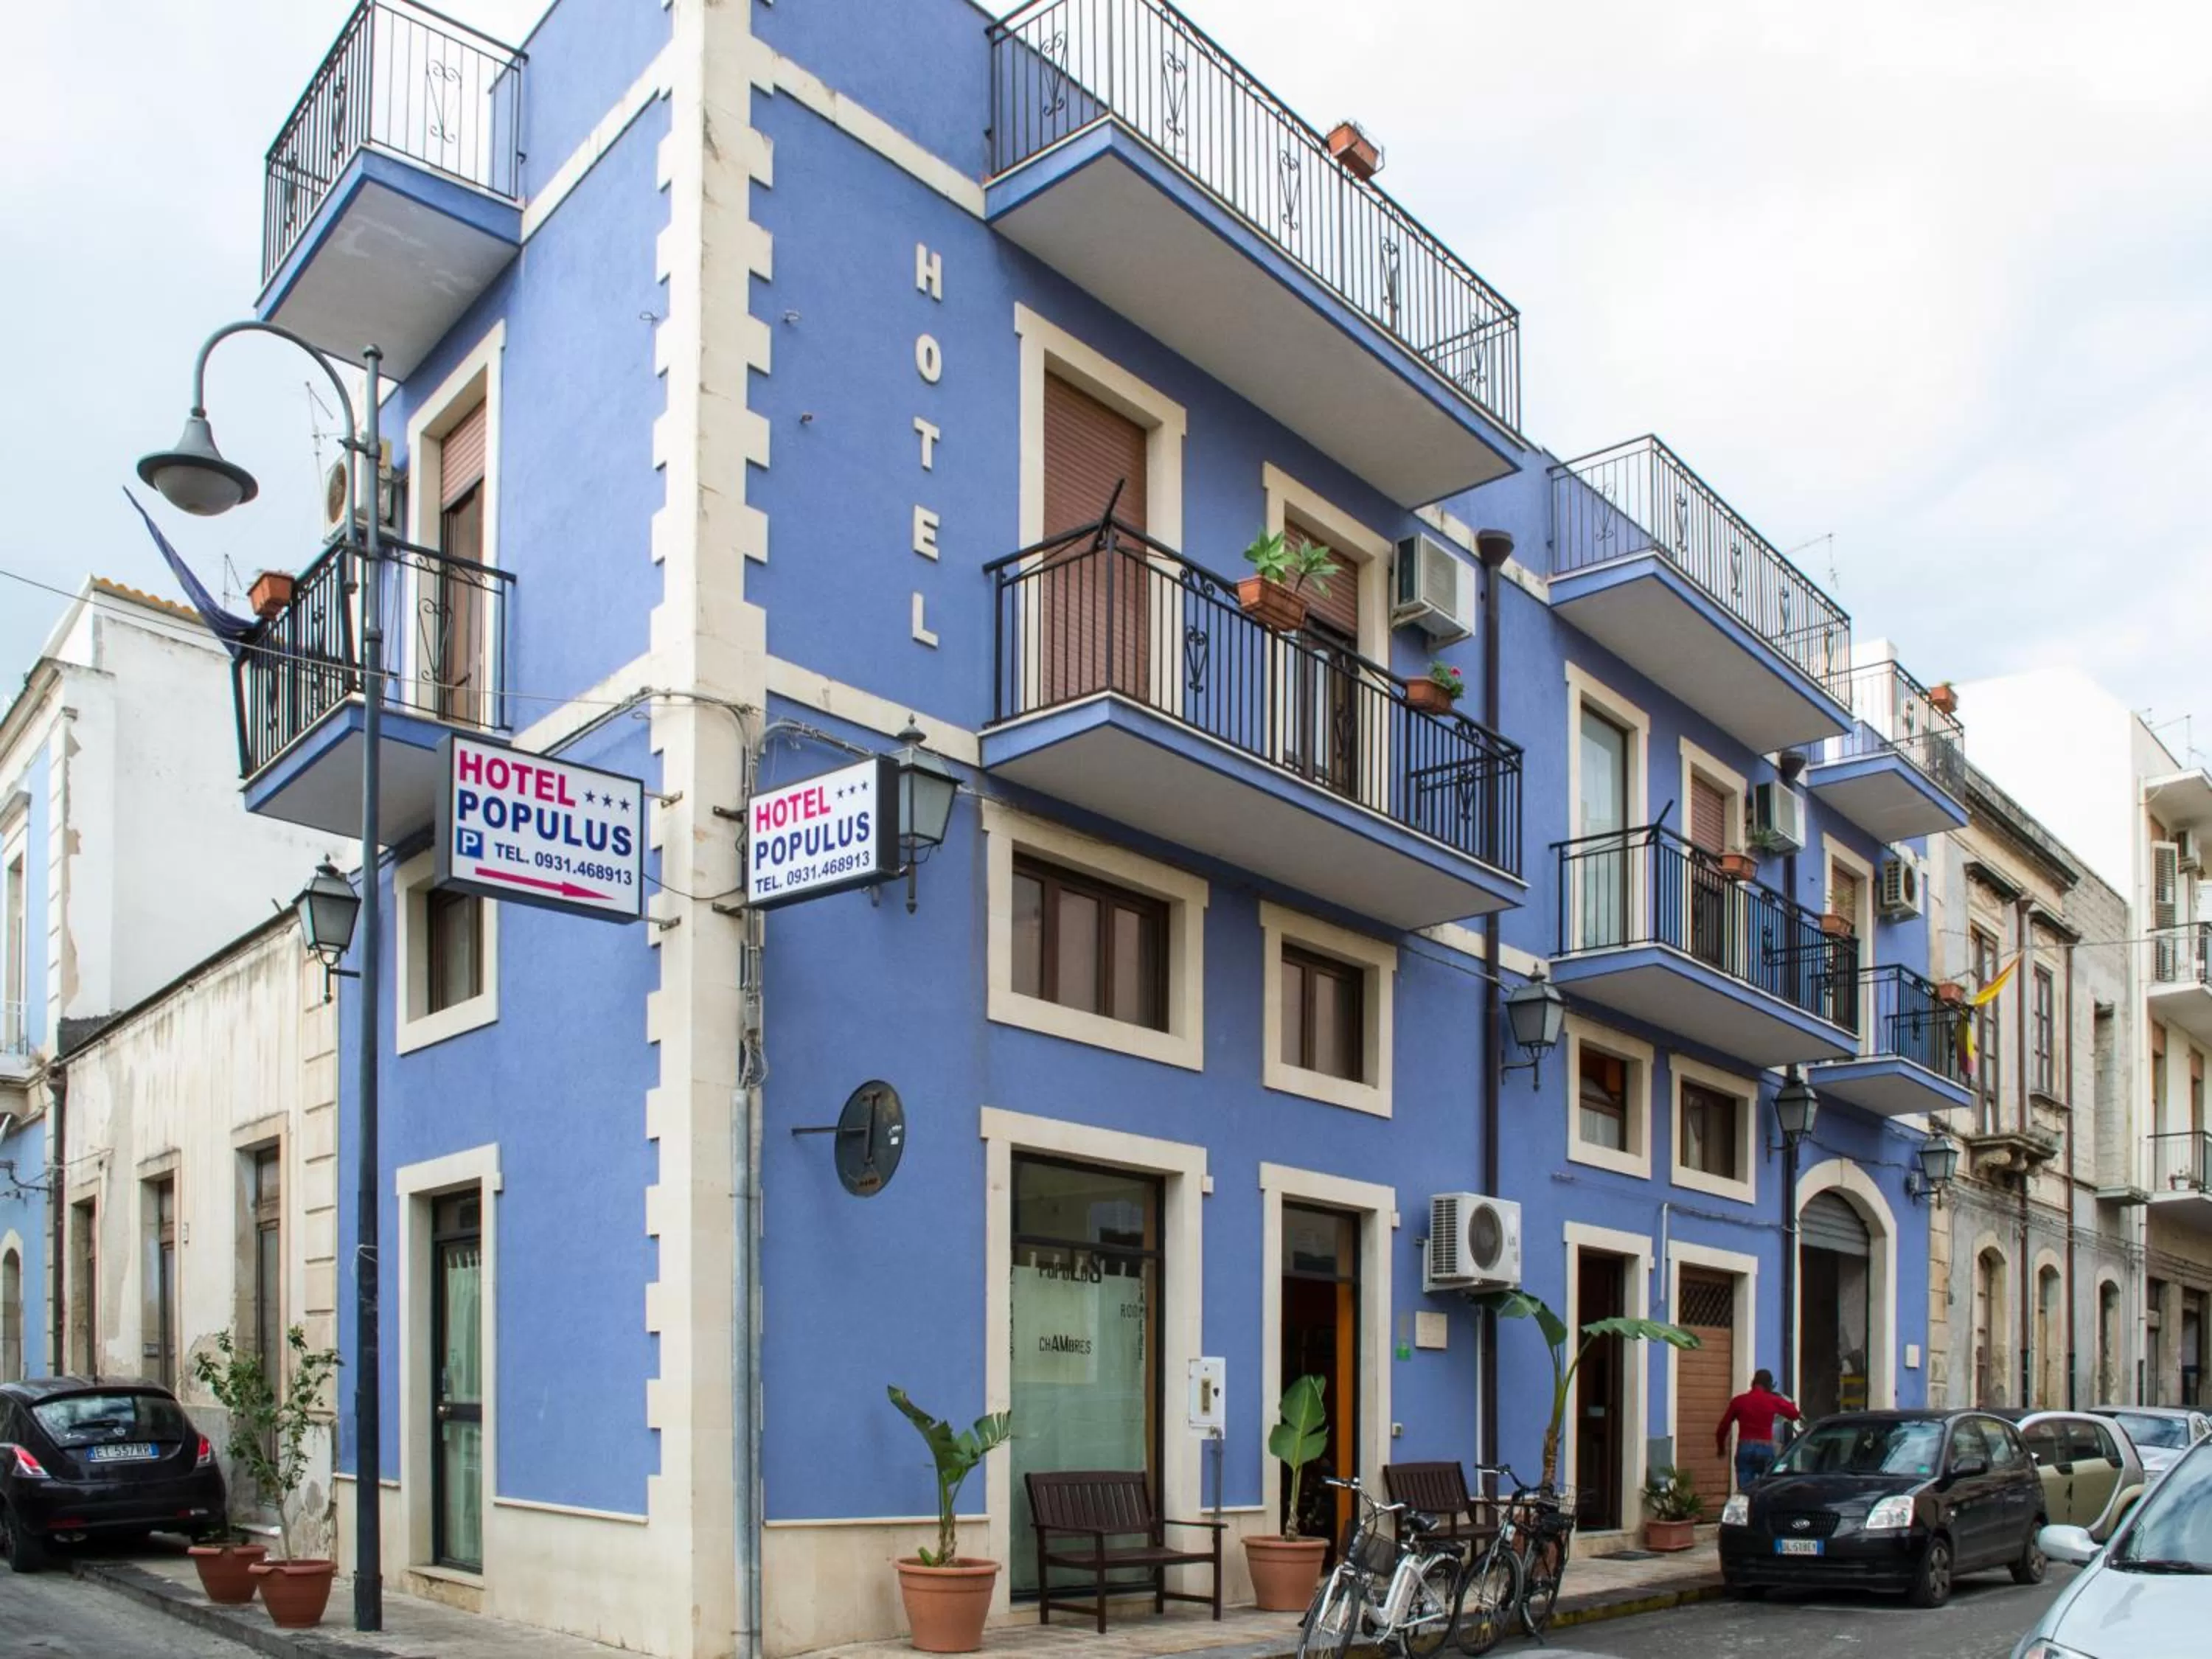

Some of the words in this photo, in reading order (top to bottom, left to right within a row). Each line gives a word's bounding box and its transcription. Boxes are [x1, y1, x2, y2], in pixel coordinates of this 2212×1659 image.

[911, 243, 942, 649] HOTEL
[459, 749, 577, 808] HOTEL
[458, 788, 632, 857] POPULUS
[756, 785, 831, 833] HOTEL
[462, 831, 479, 853] P
[494, 842, 530, 864] TEL.
[535, 851, 632, 886] 0931.468913
[755, 811, 870, 870] POPULUS
[755, 874, 782, 894] TEL.
[786, 850, 870, 886] 0931.468913
[1039, 1334, 1092, 1355] CHAMBRES
